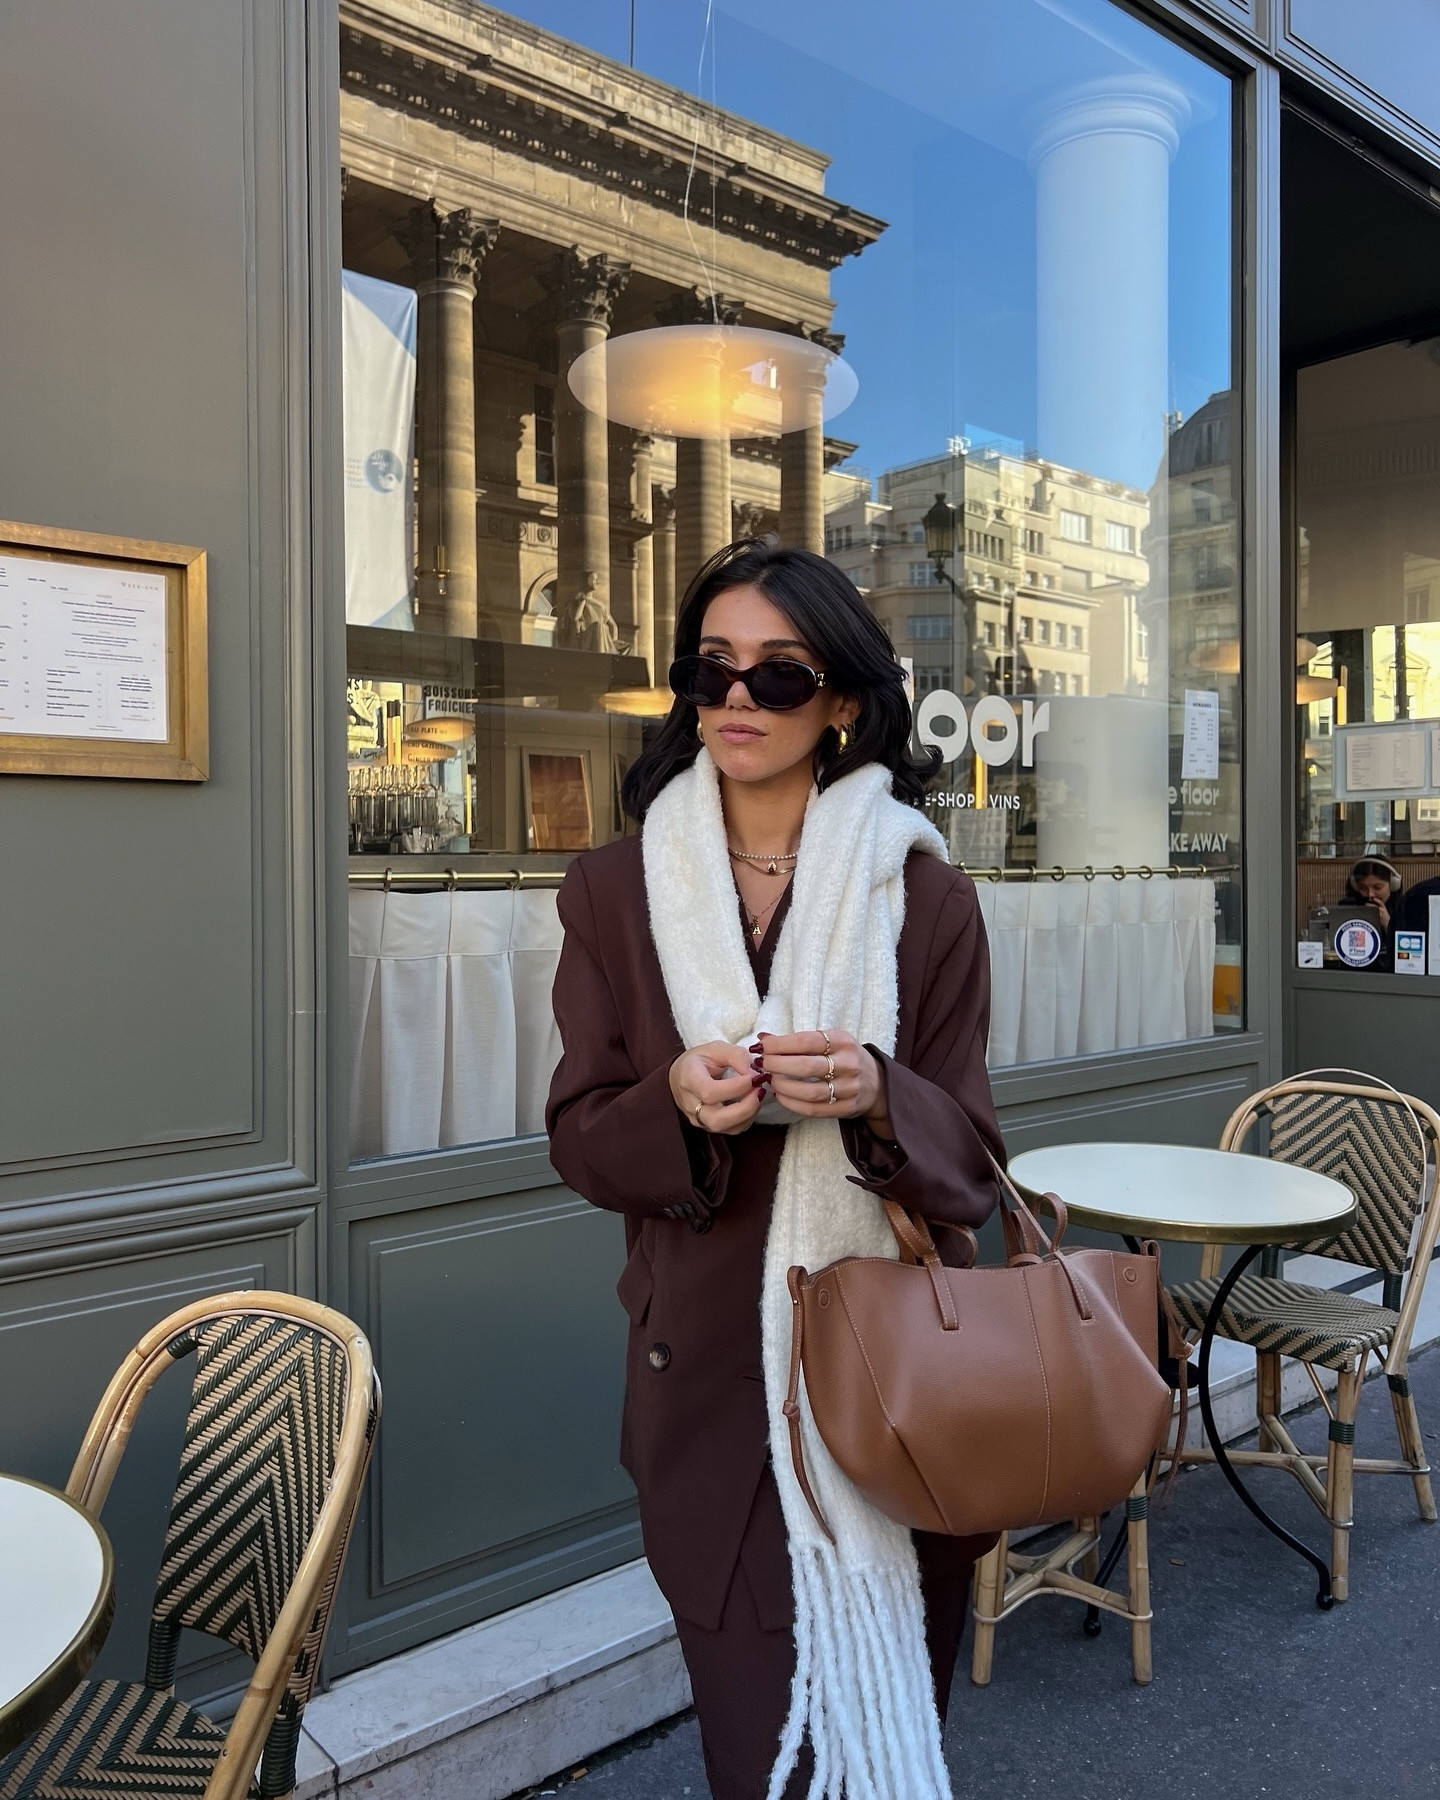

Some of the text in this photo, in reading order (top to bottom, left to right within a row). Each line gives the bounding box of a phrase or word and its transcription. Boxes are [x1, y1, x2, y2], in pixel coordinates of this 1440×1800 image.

[989, 794, 1021, 810] VINS
[1181, 780, 1220, 806] floor
[1168, 832, 1228, 852] KE AWAY
